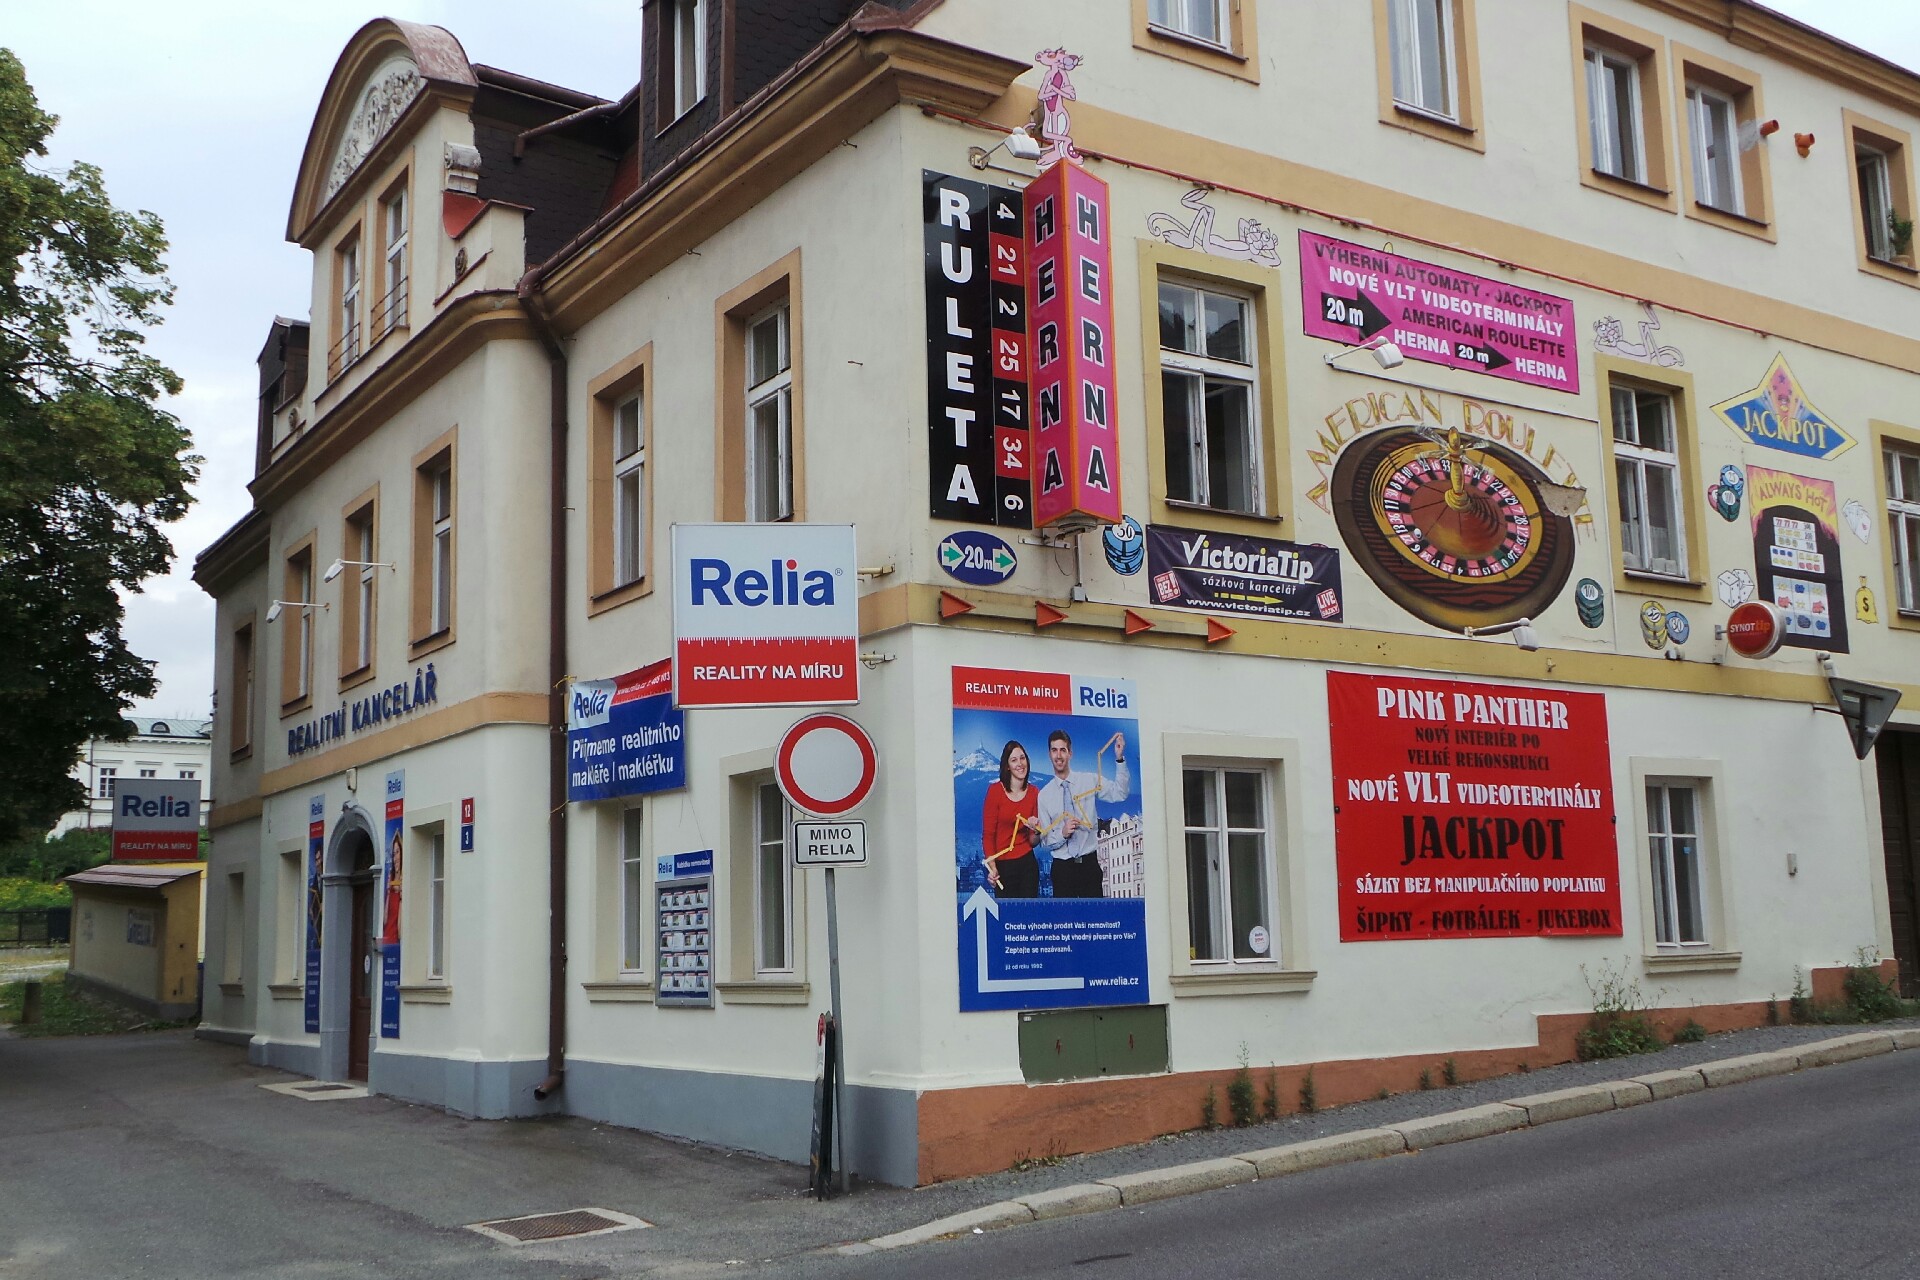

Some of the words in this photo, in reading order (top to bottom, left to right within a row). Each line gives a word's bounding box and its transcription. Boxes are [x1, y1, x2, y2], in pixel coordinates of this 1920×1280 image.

[996, 203, 1015, 221] 4
[997, 244, 1017, 276] 21
[1314, 242, 1389, 274] VÝHERNÍ
[1395, 262, 1480, 297] AUTOMATY
[1494, 289, 1562, 317] JACKPOT
[999, 297, 1018, 317] 2
[1327, 298, 1346, 322] 20
[1349, 307, 1364, 327] m
[1330, 266, 1379, 293] NOVÉ
[1384, 280, 1416, 301] VLT
[1421, 289, 1563, 337] VIDEOTERMINÁLY
[1034, 194, 1064, 497] HERNA
[1075, 192, 1110, 494] HERNA
[1394, 329, 1450, 356] HERNA
[1402, 307, 1483, 339] AMERICAN
[1488, 327, 1566, 358] ROULETTE
[939, 187, 980, 505] RULETA
[999, 340, 1019, 372] 25
[1458, 345, 1474, 360] 20
[1477, 351, 1489, 364] m
[1515, 357, 1567, 382] HERNA
[1001, 389, 1021, 421] 17
[1742, 406, 1827, 449] JACKPOT
[1003, 436, 1022, 469] 34
[1305, 388, 1443, 515] AMERICAN
[1004, 494, 1024, 511] 6
[1759, 480, 1802, 501] ALWAYS
[1181, 535, 1314, 585] VictoriaTip
[690, 558, 836, 606] Relia
[1202, 576, 1245, 591] sázková
[1249, 579, 1297, 595] kancelář
[1186, 599, 1311, 616] www.victoriatip.cz
[1317, 591, 1336, 609] LIVE
[693, 664, 767, 681] REALITY
[772, 664, 797, 680] NA
[800, 661, 844, 679] MÍRU
[965, 682, 1011, 695] REALITY
[1014, 685, 1029, 696] NA
[1033, 685, 1059, 698] MÍRU
[1079, 686, 1128, 709] Relia
[288, 700, 347, 756] REALITNÍ
[352, 663, 437, 732] KANCELÁŘ
[574, 689, 608, 719] Relia
[1377, 687, 1445, 721] PINK
[1453, 693, 1569, 730] PANTHER
[572, 737, 616, 762] Přijmeme
[622, 722, 680, 750] realitního
[1415, 724, 1450, 743] NOVÝ
[1455, 728, 1516, 748] INTERIÉR
[1522, 734, 1540, 748] PO
[1408, 747, 1450, 766] VELKÉ
[572, 763, 609, 787] makléře
[618, 753, 673, 780] makléřku
[1348, 774, 1399, 802] NOVÉ
[1403, 771, 1450, 804] VLT
[1457, 782, 1601, 809] VIDEOTERMINÁLY
[122, 795, 190, 817] Relia
[464, 804, 471, 817] 12
[171, 841, 192, 850] MÍRU
[809, 827, 852, 841] MIMO
[1400, 815, 1565, 866] JACKPOT
[808, 843, 855, 857] RELIA
[1356, 873, 1400, 895] SÁZKY
[1405, 877, 1431, 893] BEZ
[1435, 873, 1539, 893] MANIPULAČNÍHO
[1543, 877, 1606, 893] POPLATKU
[1004, 922, 1027, 930] Chcete
[1054, 922, 1073, 931] prodat
[1074, 921, 1086, 929] Vaši
[1088, 921, 1121, 929] nemovitost?
[1357, 906, 1413, 934] ŠIPKY
[1432, 904, 1520, 930] FOTBÁLEK
[1537, 908, 1611, 931] JUKEBOX
[1004, 934, 1029, 942] Hledáte
[1030, 934, 1043, 942] dům
[1061, 933, 1070, 942] byt
[1071, 933, 1092, 942] vhodný
[1113, 933, 1122, 941] pro
[1123, 932, 1136, 940] Vás?
[1005, 946, 1030, 954] Zeptejte
[1089, 977, 1139, 988] www.relia.cz
